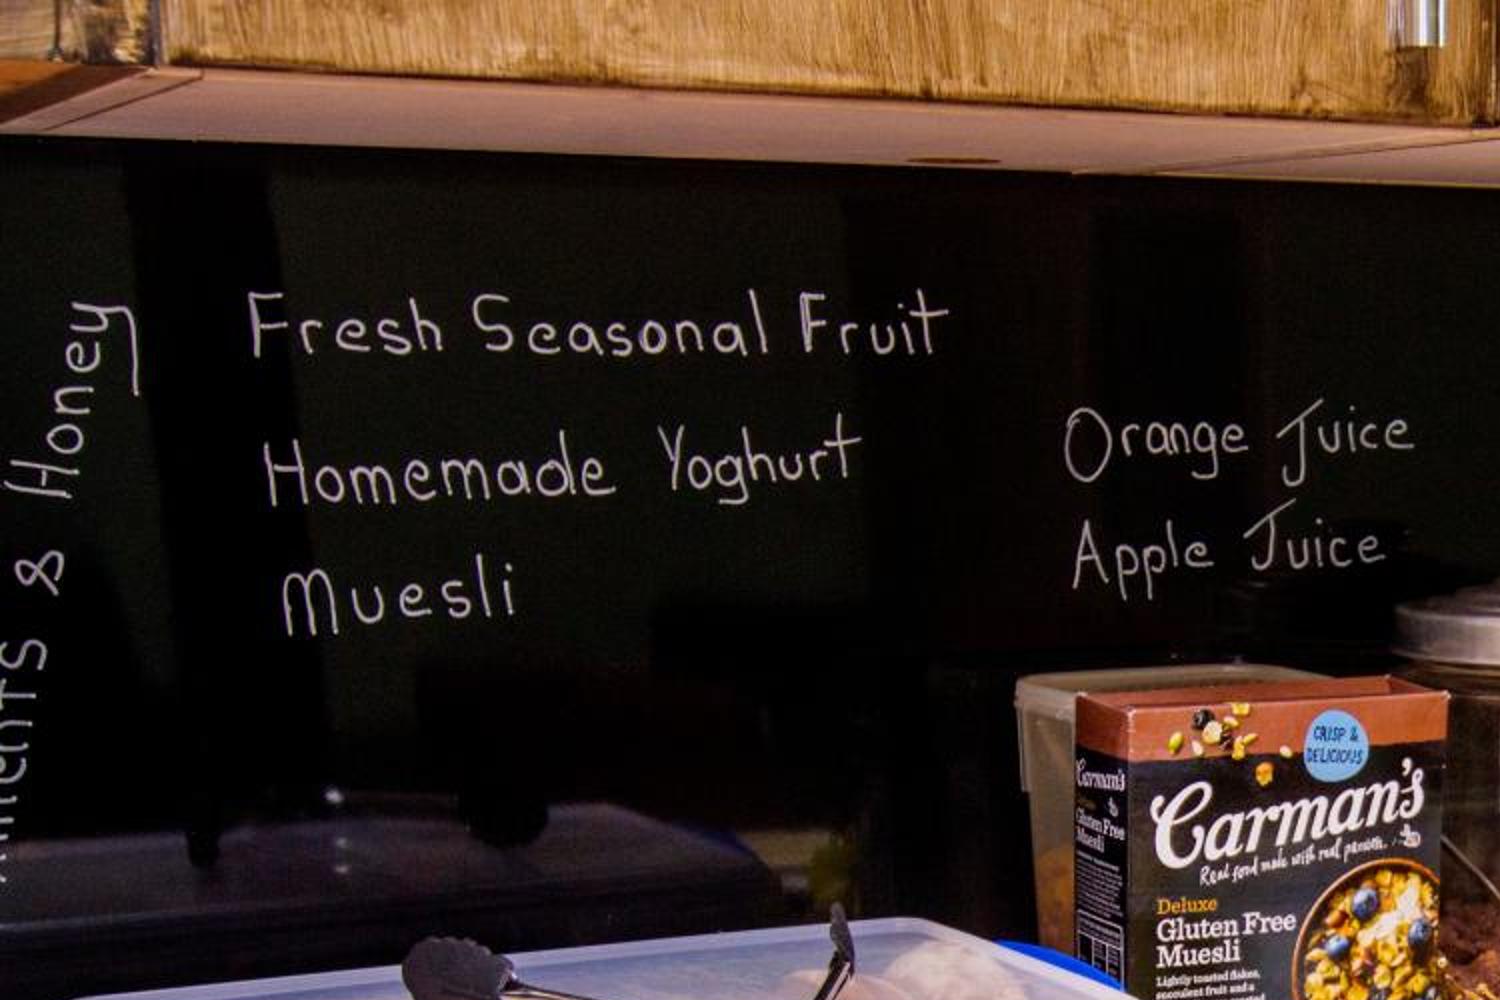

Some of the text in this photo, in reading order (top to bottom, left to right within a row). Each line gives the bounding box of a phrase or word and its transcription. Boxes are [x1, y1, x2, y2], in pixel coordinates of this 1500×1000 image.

[248, 289, 949, 358] Fresh Seasonal Fruit
[3, 302, 140, 499] Honey
[263, 412, 862, 507] Homemade Yoghurt
[1064, 399, 1415, 487] Orange Juice
[1072, 498, 1386, 601] Apple Juice
[14, 550, 65, 596] &
[283, 553, 516, 636] Muesli
[1313, 725, 1359, 741] CRISP &
[1075, 757, 1126, 792] Carman's
[1306, 747, 1364, 765] DELICIOUS
[1102, 817, 1126, 841] Free
[1150, 756, 1426, 869] Carman's
[1199, 863, 1230, 887] Real
[1231, 856, 1259, 883] food
[1290, 844, 1317, 867] with
[1156, 896, 1217, 915] Deluxe
[1156, 911, 1297, 942] Gluten Free
[1155, 938, 1241, 968] Muesli
[1205, 984, 1228, 997] fruit
